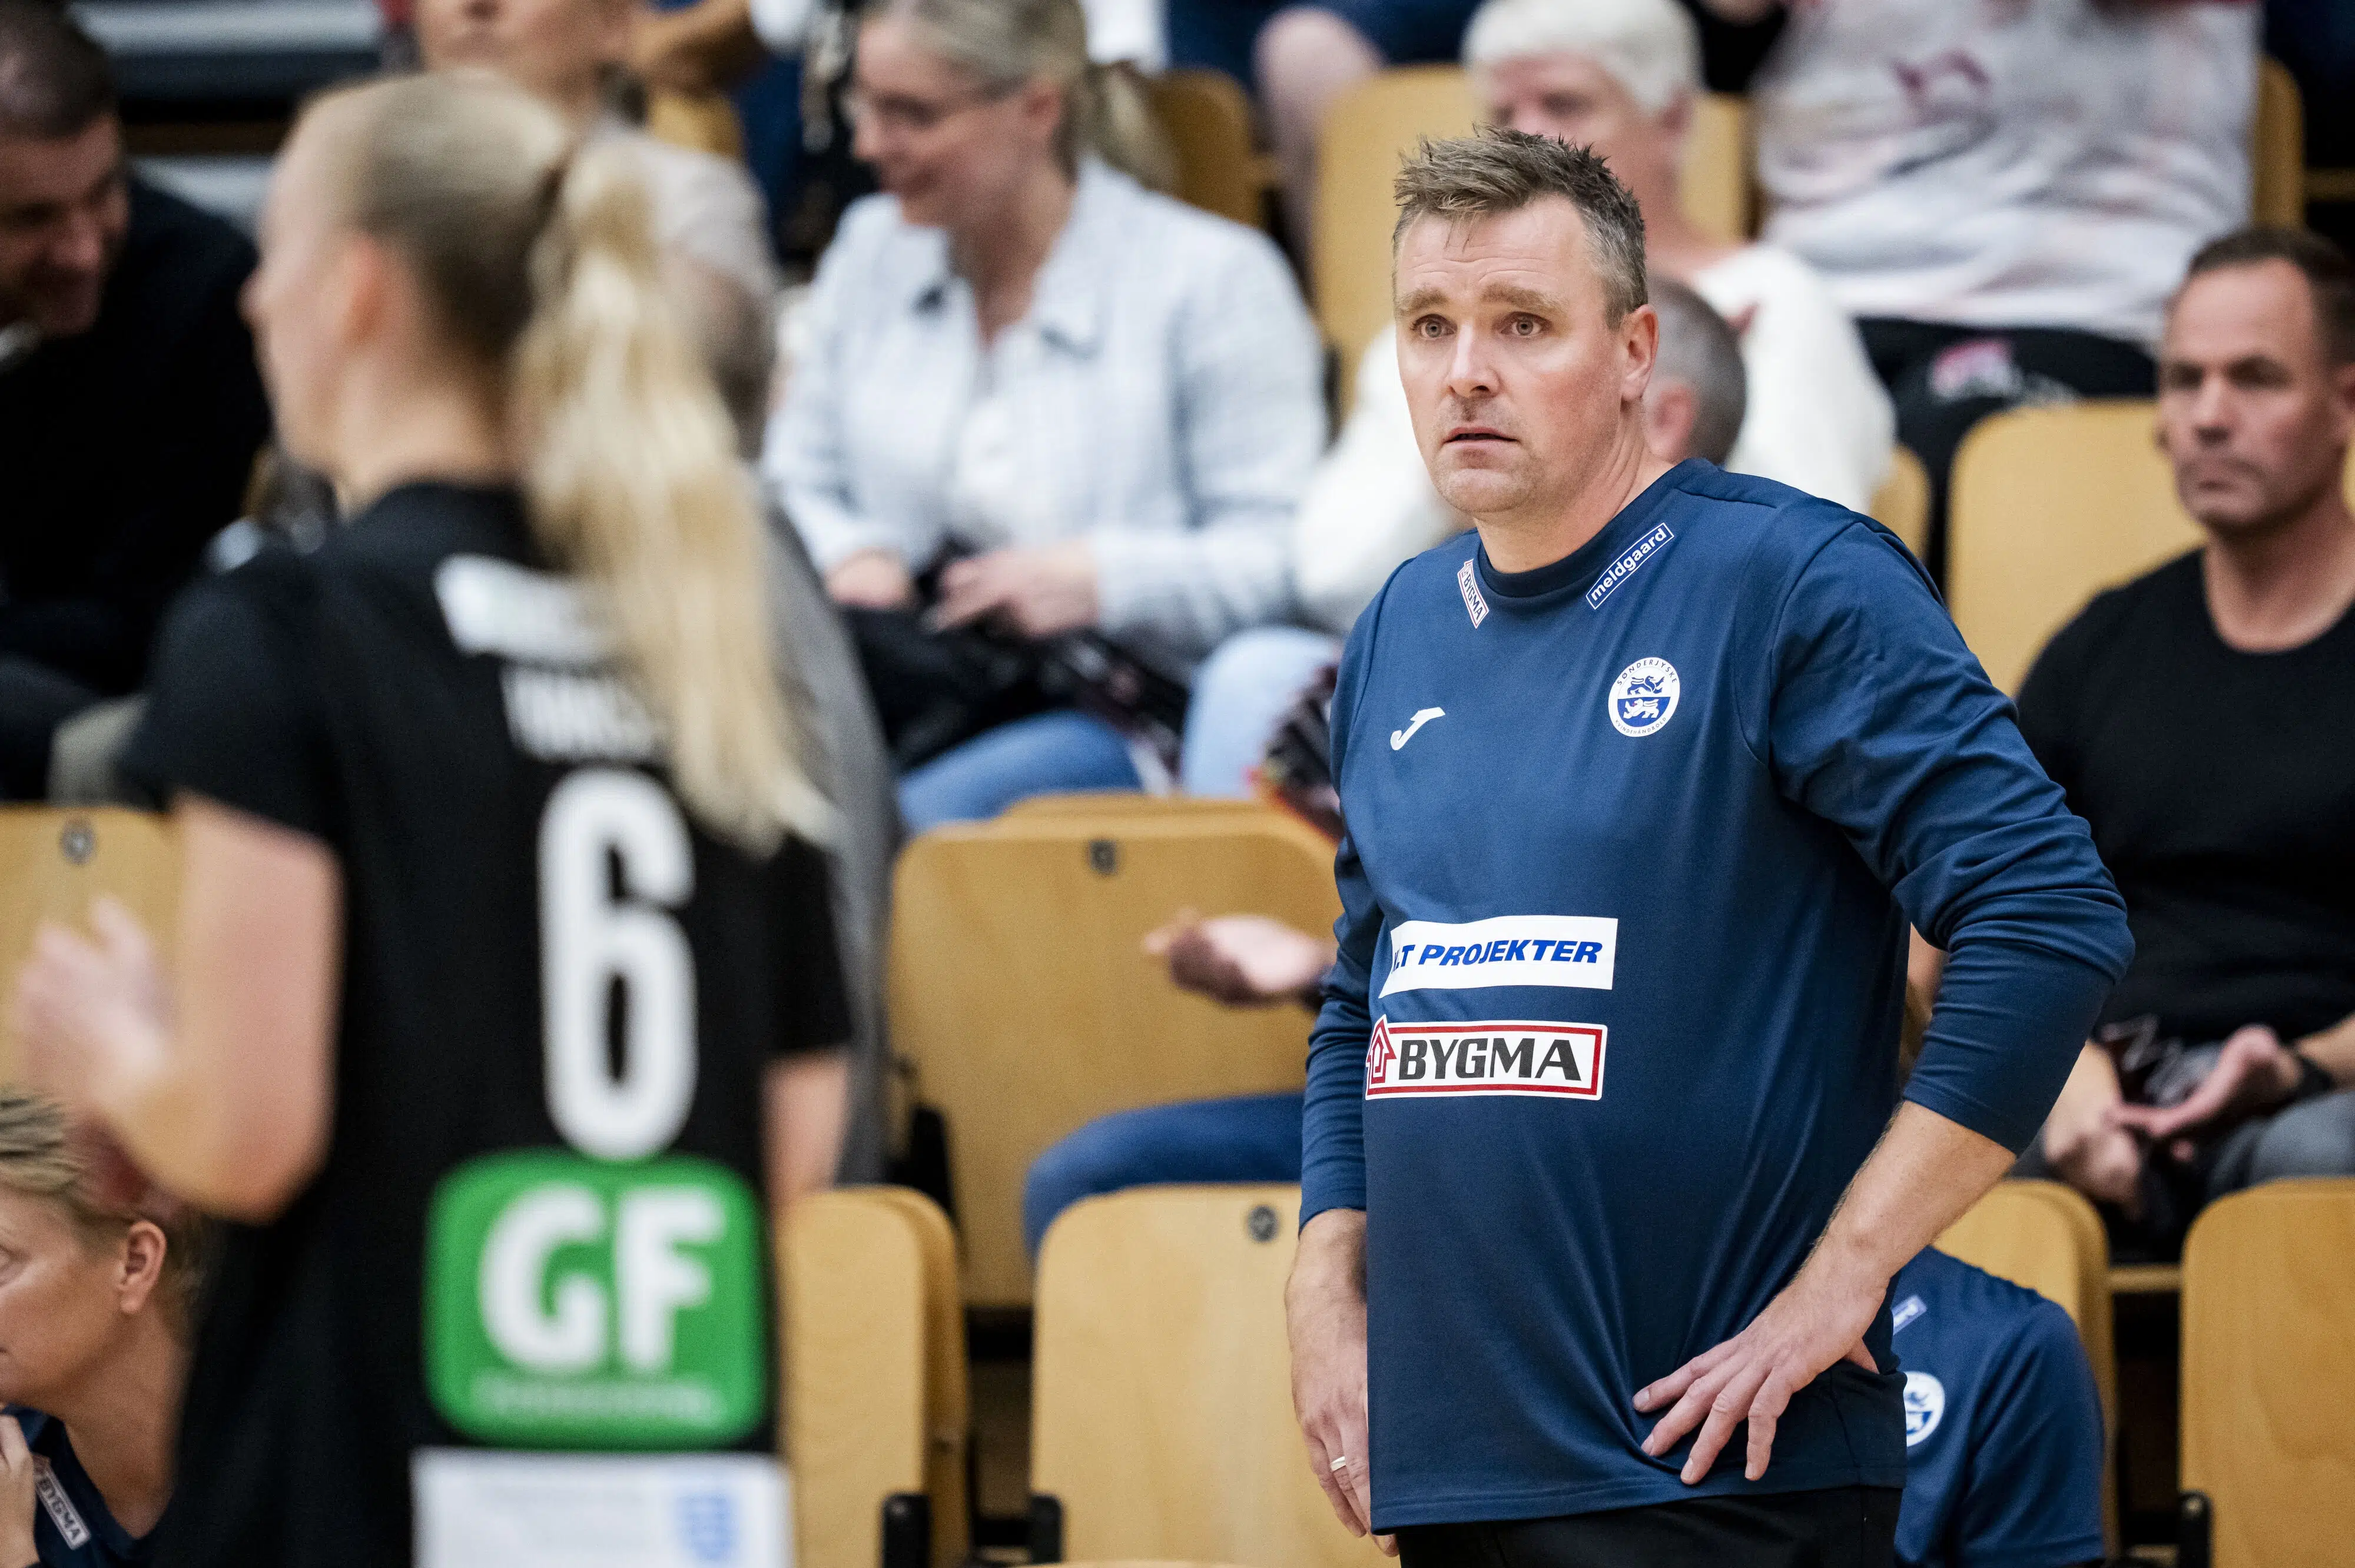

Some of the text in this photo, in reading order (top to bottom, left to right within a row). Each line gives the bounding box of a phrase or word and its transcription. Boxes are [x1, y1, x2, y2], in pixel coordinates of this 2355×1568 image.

[1591, 527, 1667, 602] meldgaard
[1464, 573, 1483, 620] BYGMA
[1617, 659, 1677, 686] SØNDERJYSKE
[536, 765, 699, 1160] 6
[1418, 939, 1603, 966] PROJEKTER
[1398, 1038, 1582, 1081] BYGMA
[478, 1180, 725, 1374] GF
